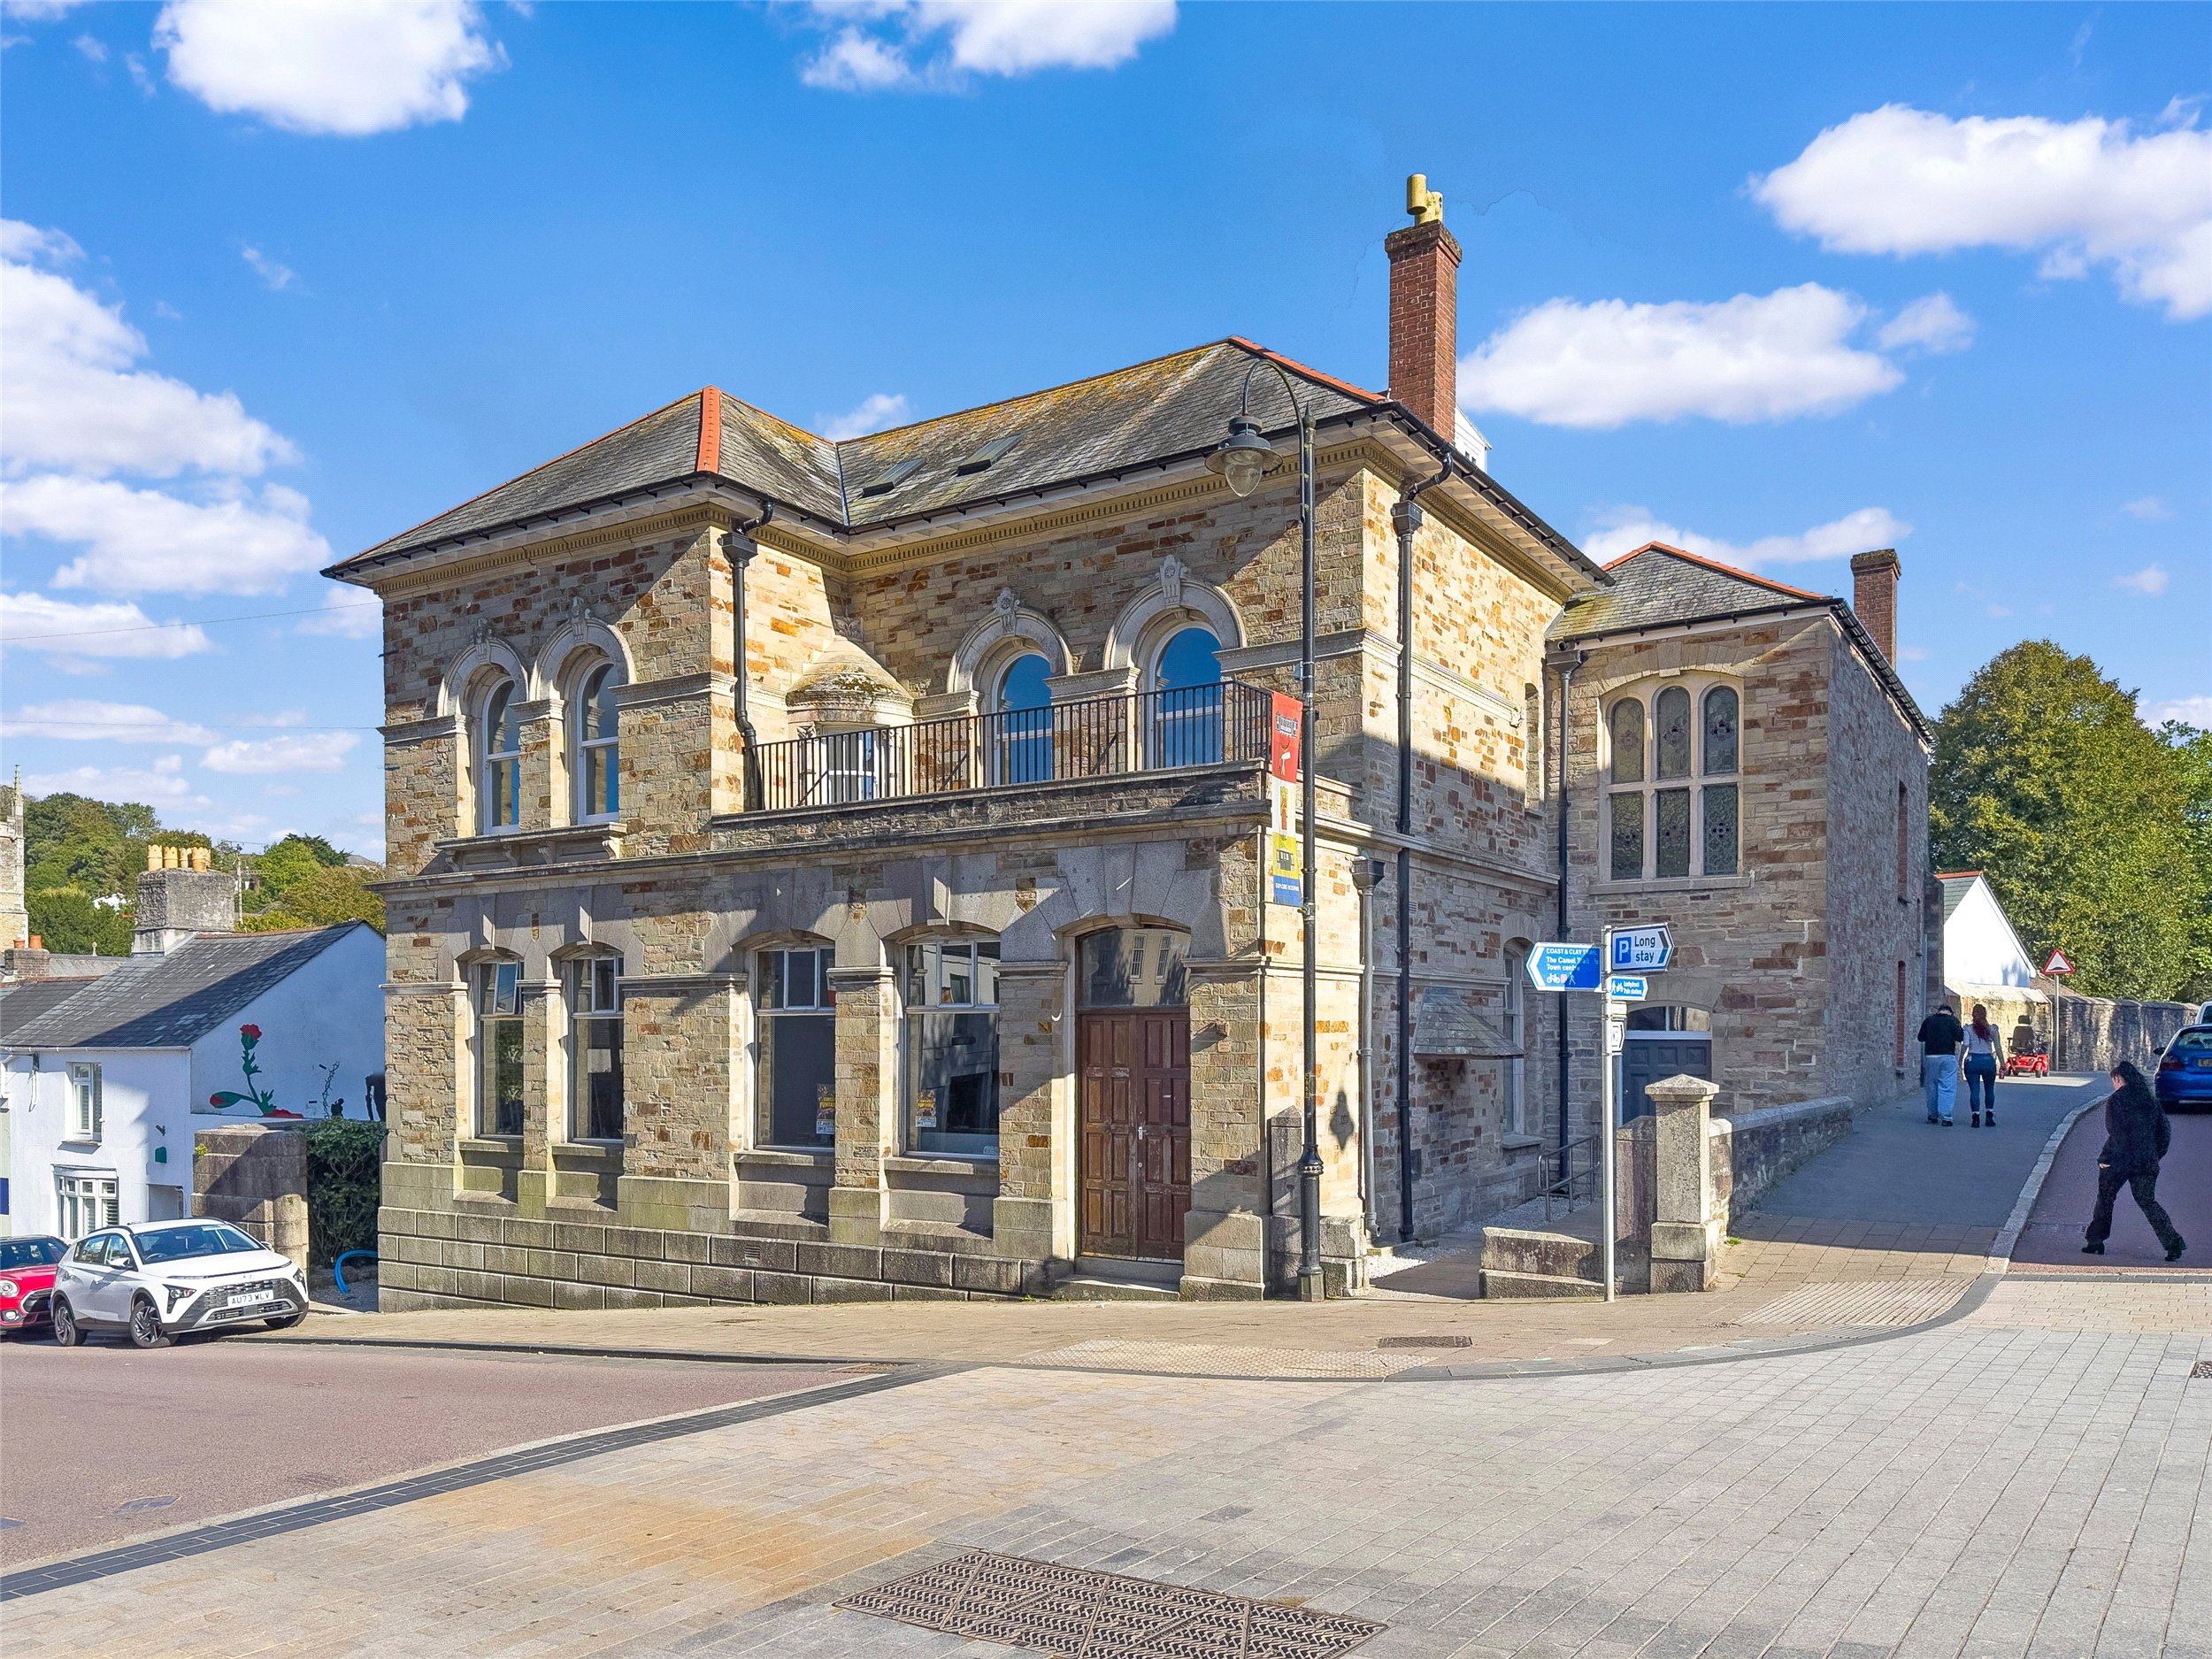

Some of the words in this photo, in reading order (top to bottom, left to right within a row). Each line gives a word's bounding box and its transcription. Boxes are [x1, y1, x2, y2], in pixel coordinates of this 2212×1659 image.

[1634, 935, 1655, 948] Long
[1619, 940, 1630, 962] P
[1635, 949, 1655, 964] stay
[231, 1294, 253, 1304] AU73
[254, 1292, 270, 1301] WLV
